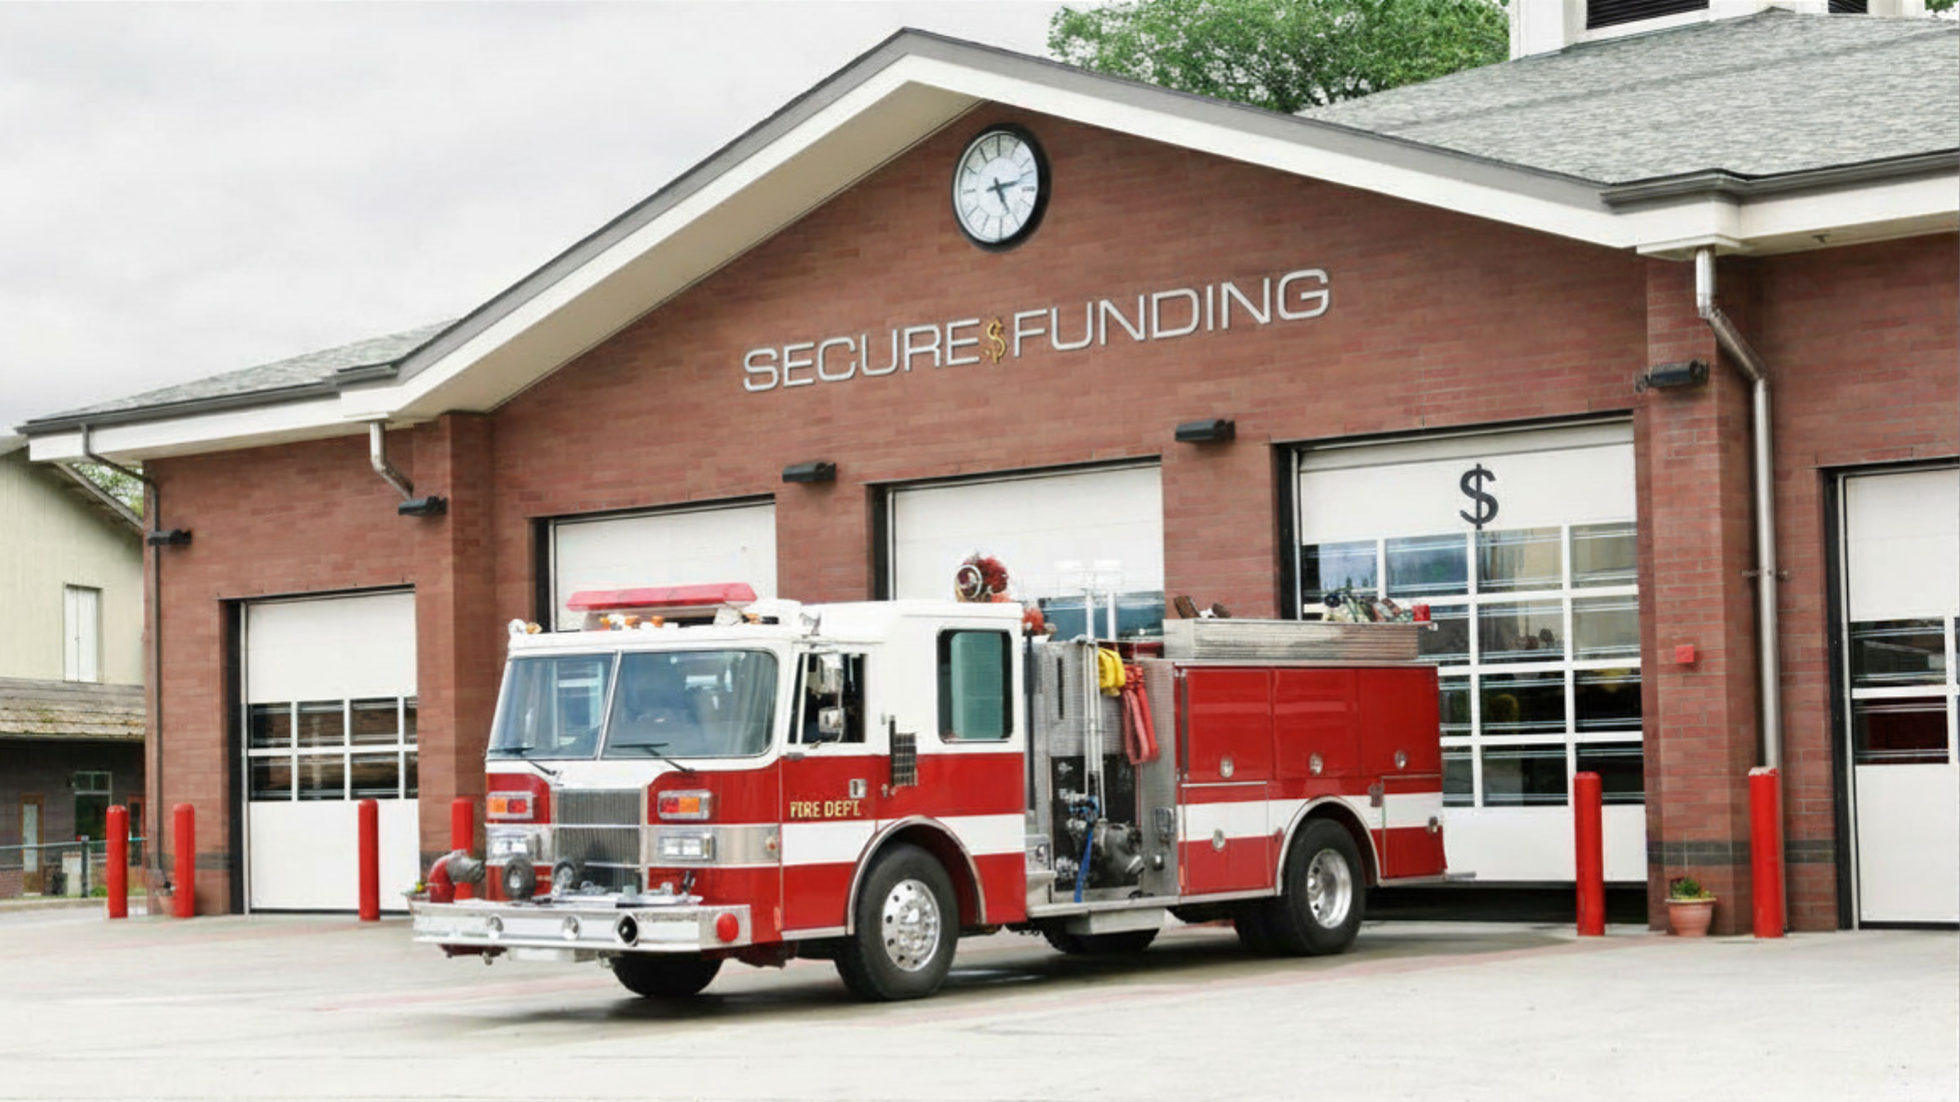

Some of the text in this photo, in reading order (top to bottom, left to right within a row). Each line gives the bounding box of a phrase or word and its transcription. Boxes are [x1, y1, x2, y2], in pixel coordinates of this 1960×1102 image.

[743, 317, 980, 392] SECURE
[1013, 268, 1331, 357] FUNDING
[1460, 463, 1499, 530] $
[790, 801, 820, 818] FIRE
